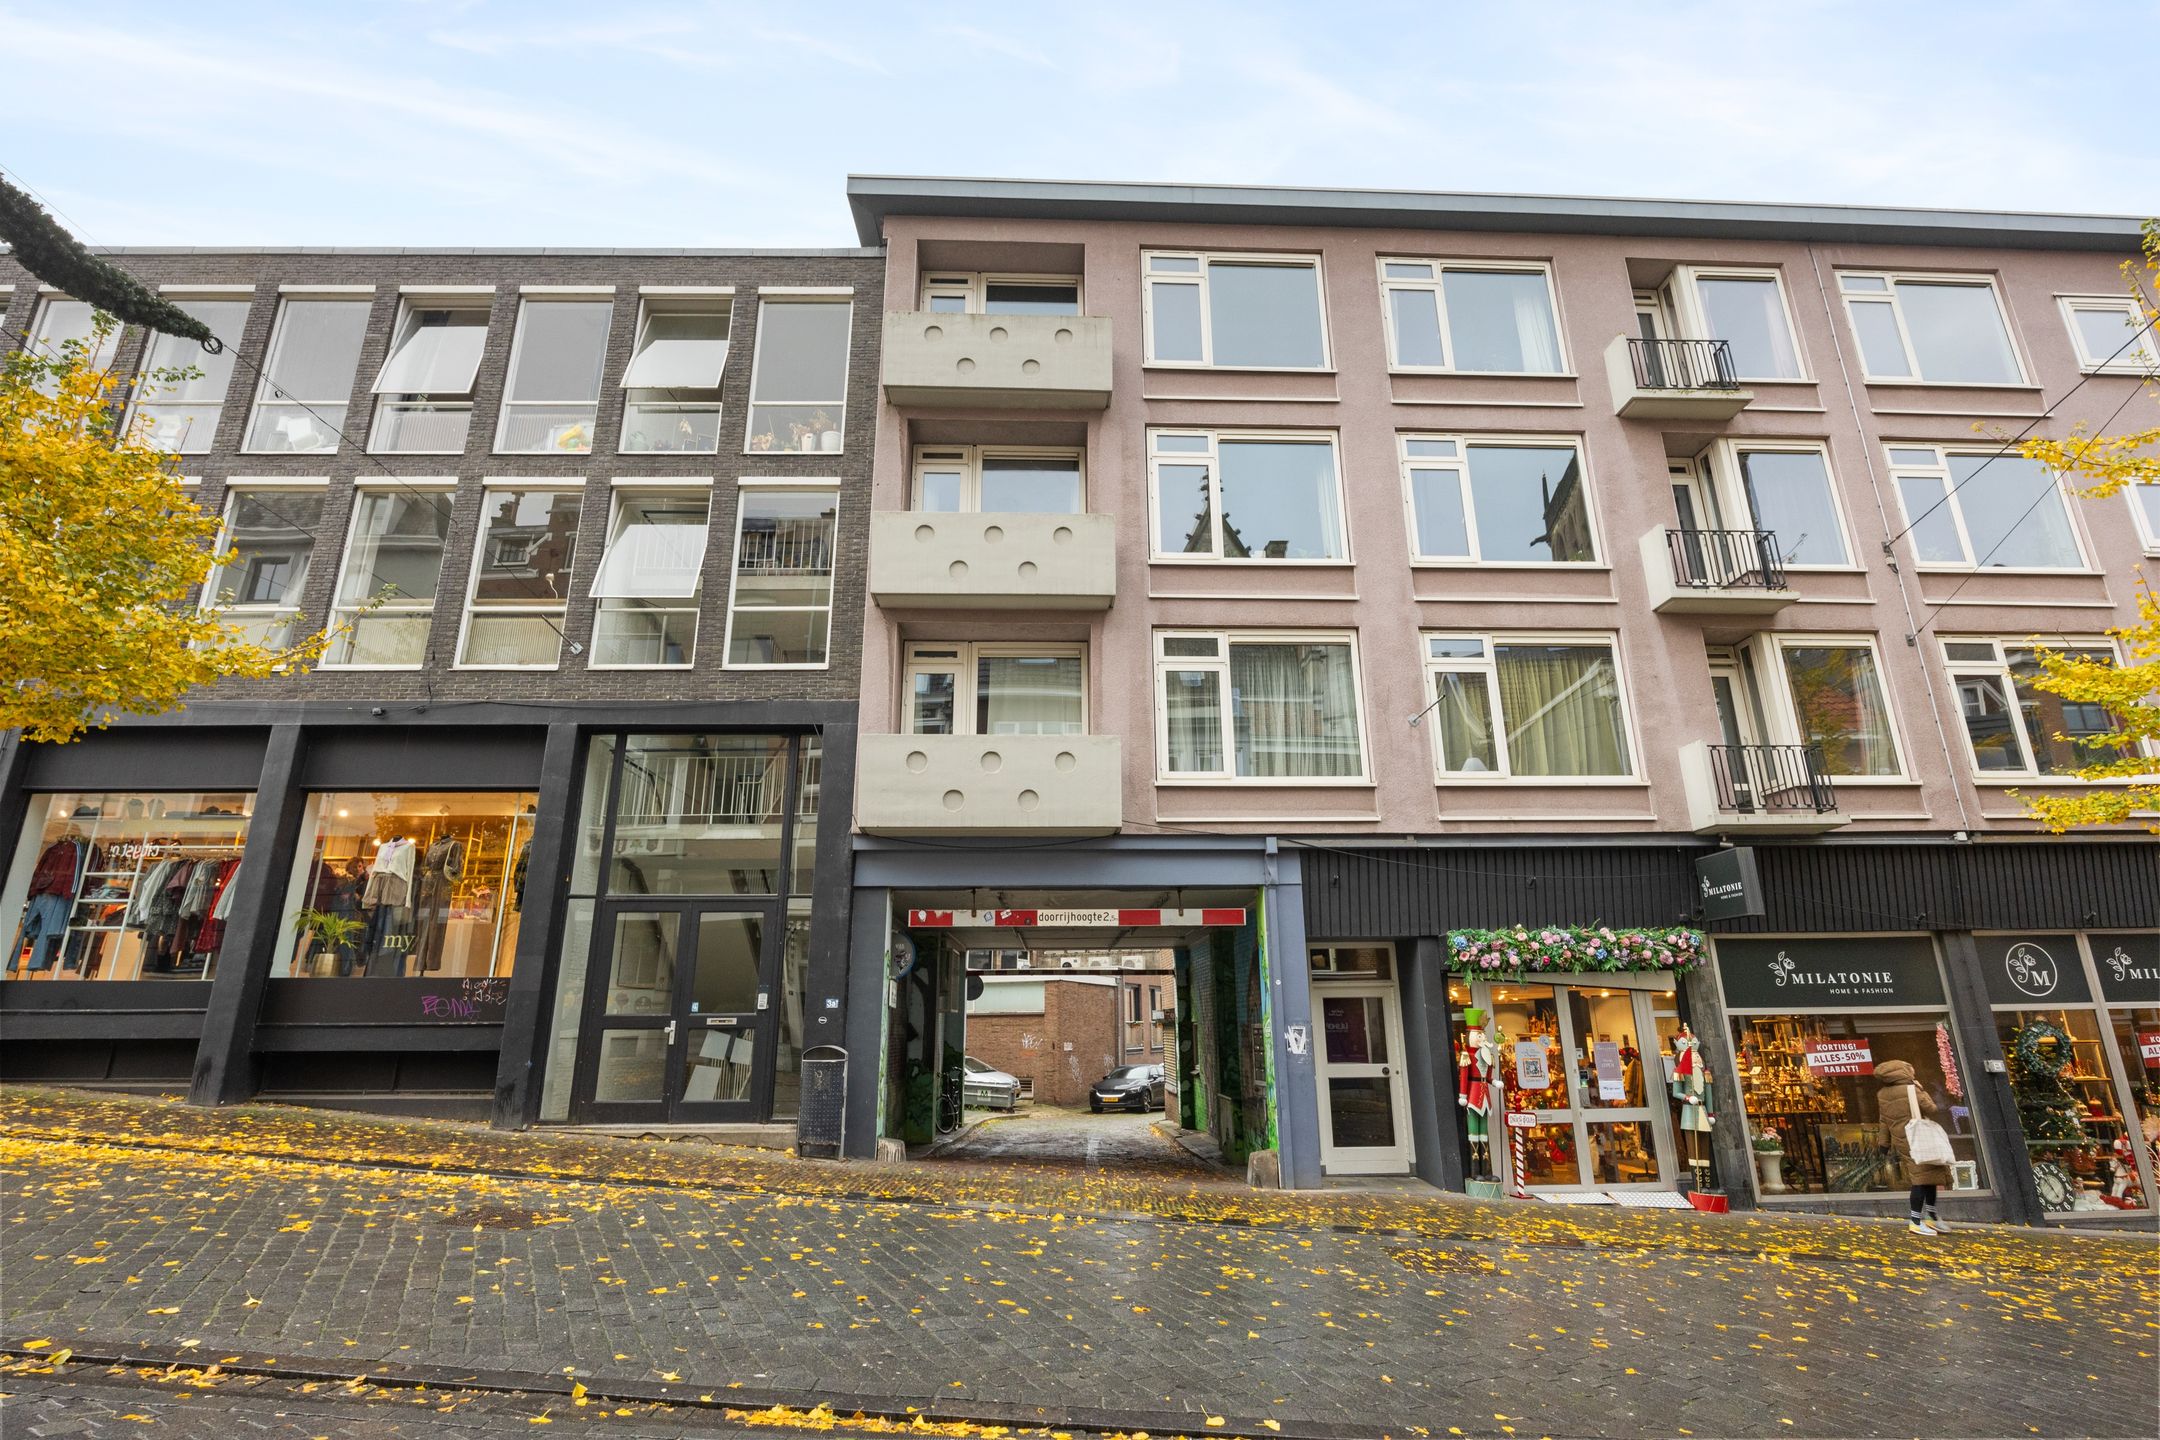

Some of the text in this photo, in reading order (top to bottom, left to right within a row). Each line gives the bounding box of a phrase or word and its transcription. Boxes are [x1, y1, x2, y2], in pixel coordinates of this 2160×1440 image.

[1708, 882, 1742, 895] MILATONIE
[1038, 912, 1102, 924] doorrijhoogte
[383, 934, 416, 952] my
[1791, 972, 1893, 985] MILATONIE
[2032, 970, 2052, 986] M
[1816, 1043, 1857, 1051] KORTING!
[1813, 1053, 1840, 1064] ALLES
[1823, 1065, 1860, 1073] RABATT!
